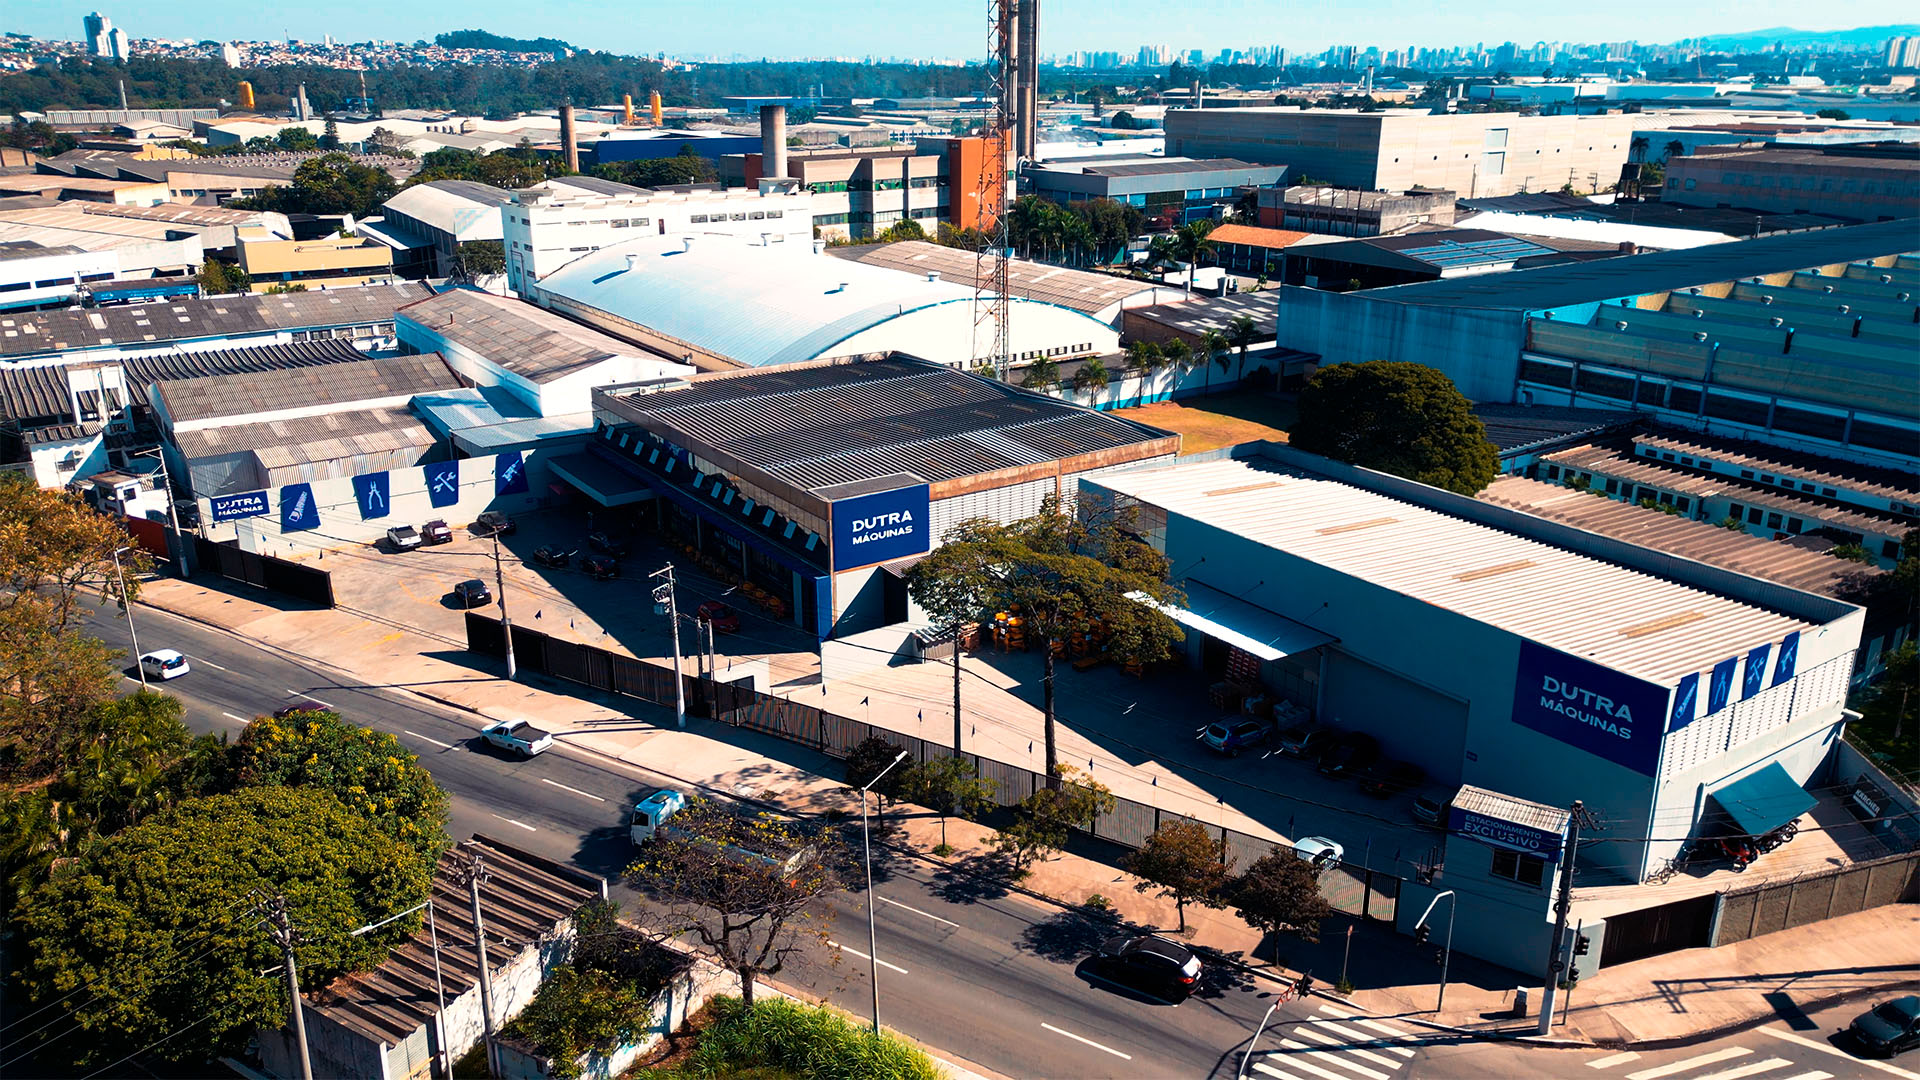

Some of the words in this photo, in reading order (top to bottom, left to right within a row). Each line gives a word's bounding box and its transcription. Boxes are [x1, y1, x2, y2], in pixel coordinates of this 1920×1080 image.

[217, 496, 262, 510] DUTRA
[852, 509, 913, 533] DUTRA
[852, 525, 913, 545] MÁQUINAS
[1542, 675, 1633, 723] DUTRA
[1540, 696, 1632, 740] MÁQUINAS
[1464, 821, 1540, 849] EXCLUSIVO
[1465, 814, 1542, 839] ESTACIONAMENTO
